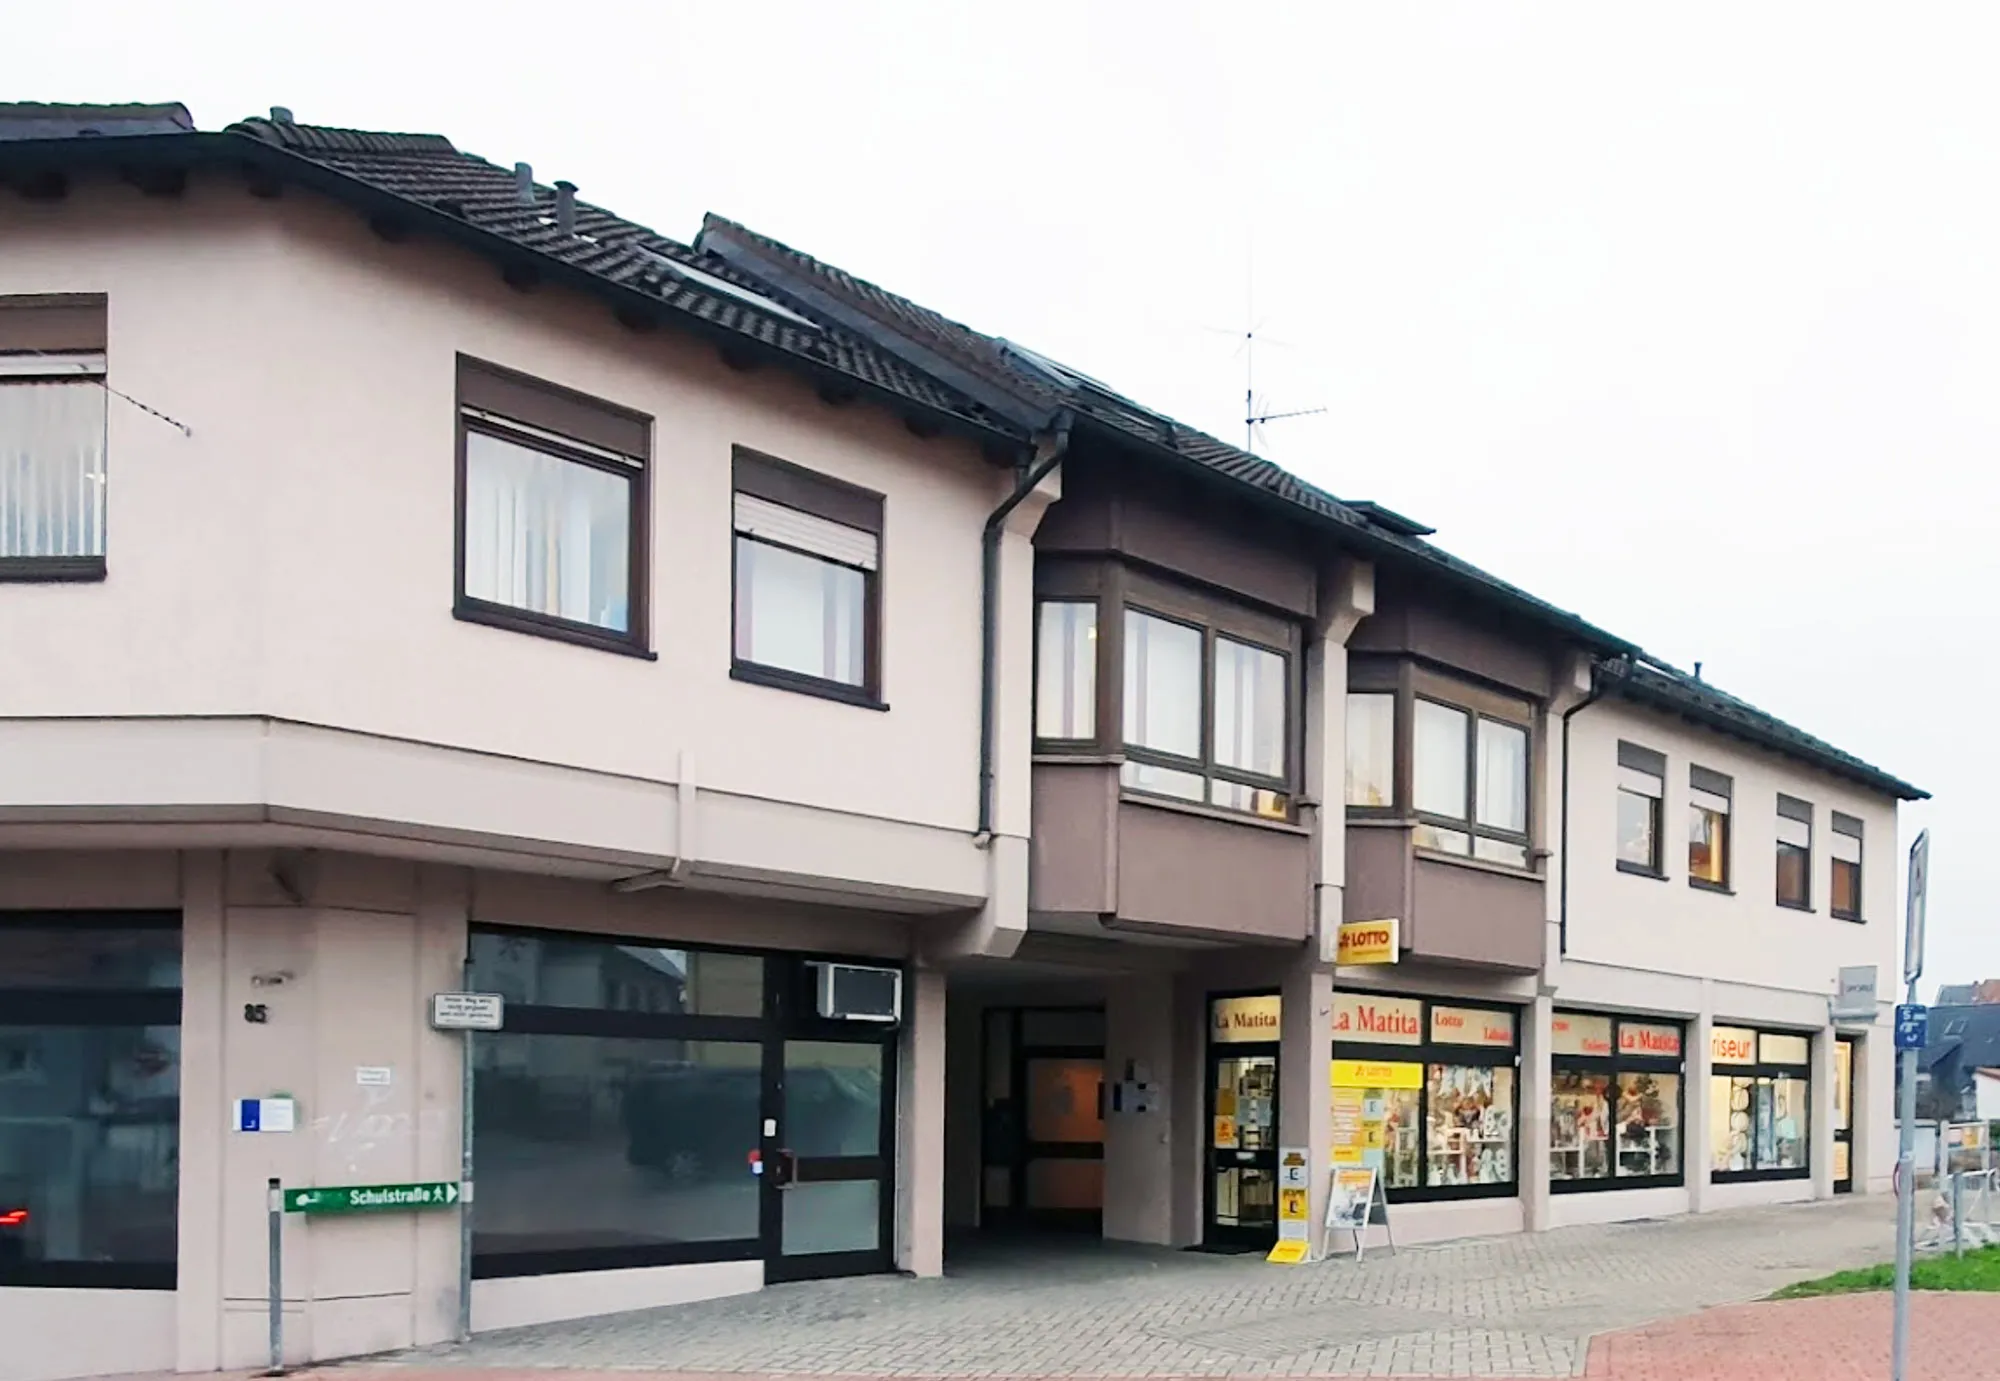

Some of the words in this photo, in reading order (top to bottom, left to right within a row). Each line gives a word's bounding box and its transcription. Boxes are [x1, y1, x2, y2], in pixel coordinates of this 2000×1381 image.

[1352, 931, 1389, 946] LOTTO
[244, 1003, 267, 1023] 85
[1234, 1011, 1277, 1028] Matita
[1357, 1005, 1418, 1034] Matita
[350, 1187, 430, 1204] Schulstraße
